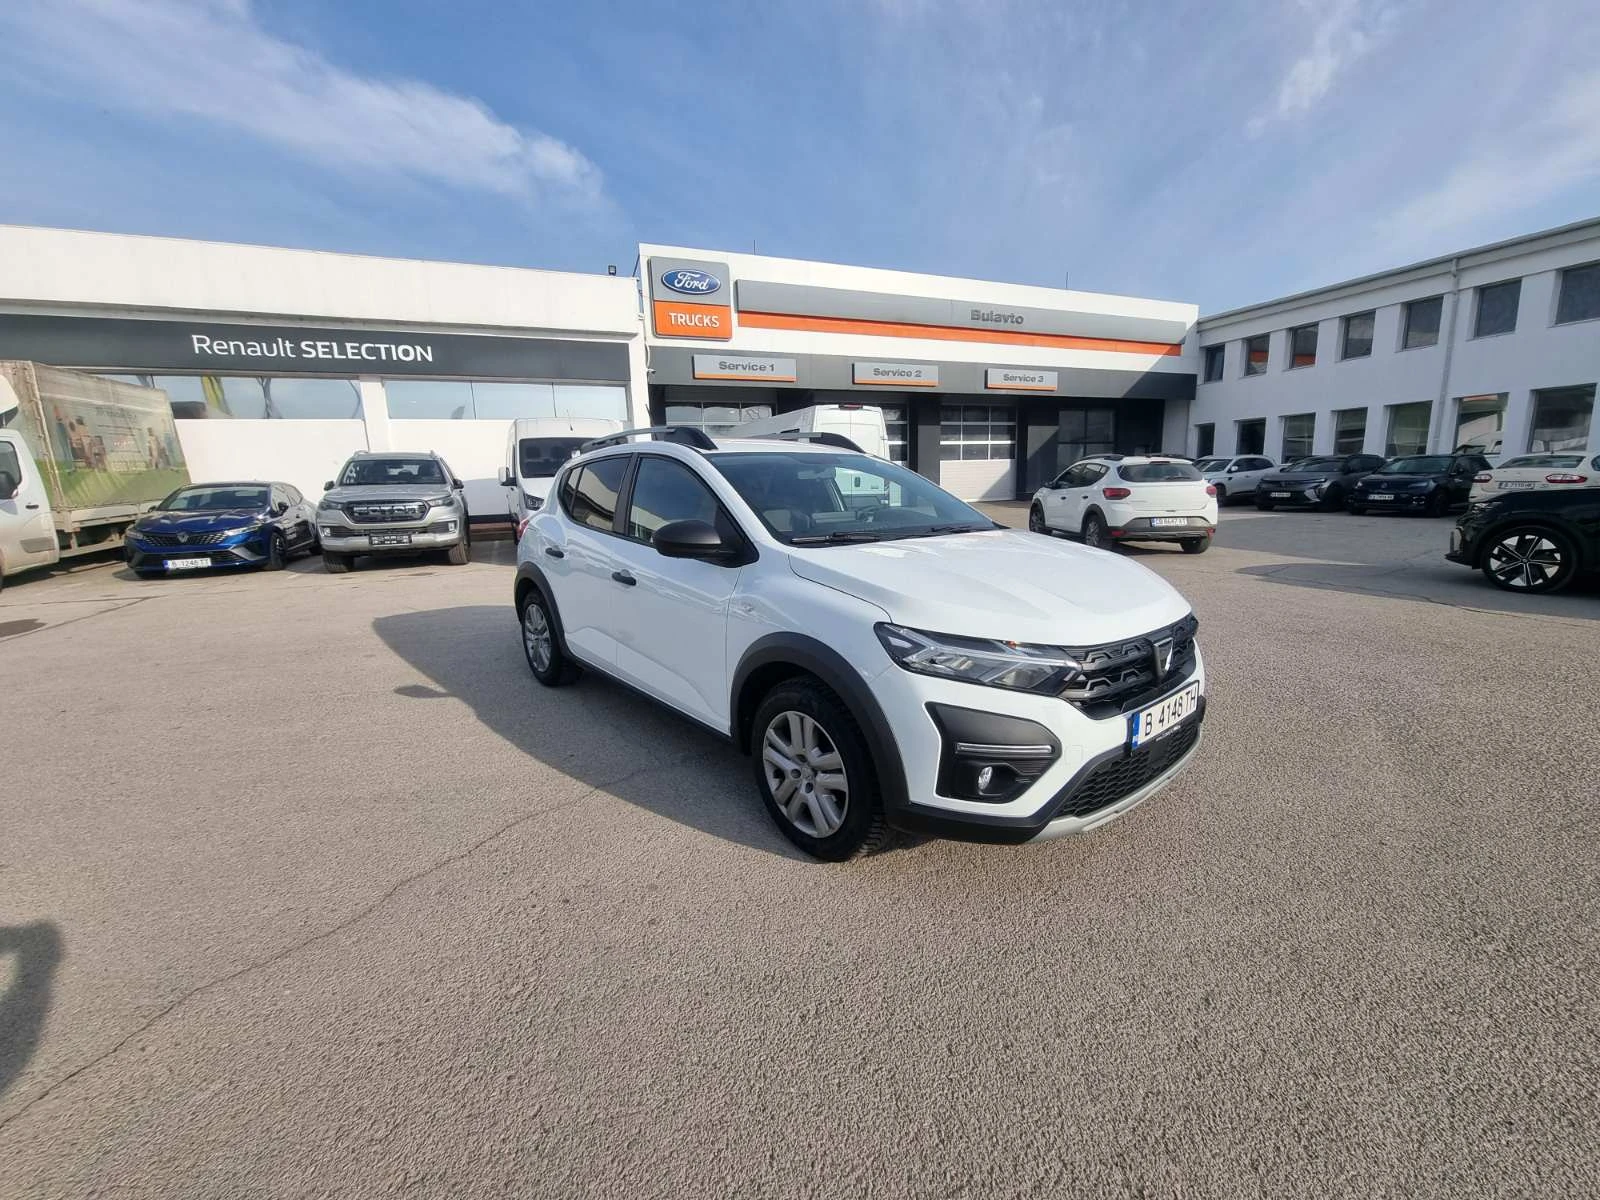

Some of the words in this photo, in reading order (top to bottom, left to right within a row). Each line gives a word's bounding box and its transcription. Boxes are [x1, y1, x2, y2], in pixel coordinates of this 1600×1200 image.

[674, 271, 711, 290] Ford
[668, 312, 720, 328] TRUCKS
[192, 334, 296, 358] Renault
[300, 340, 433, 362] SELECTION
[718, 360, 766, 372] Service
[769, 363, 776, 372] 1
[873, 367, 912, 378] Service
[914, 369, 922, 378] 2
[1002, 373, 1036, 383] Service
[1037, 375, 1044, 383] 3
[1145, 712, 1153, 737] B
[1185, 686, 1197, 713] TH
